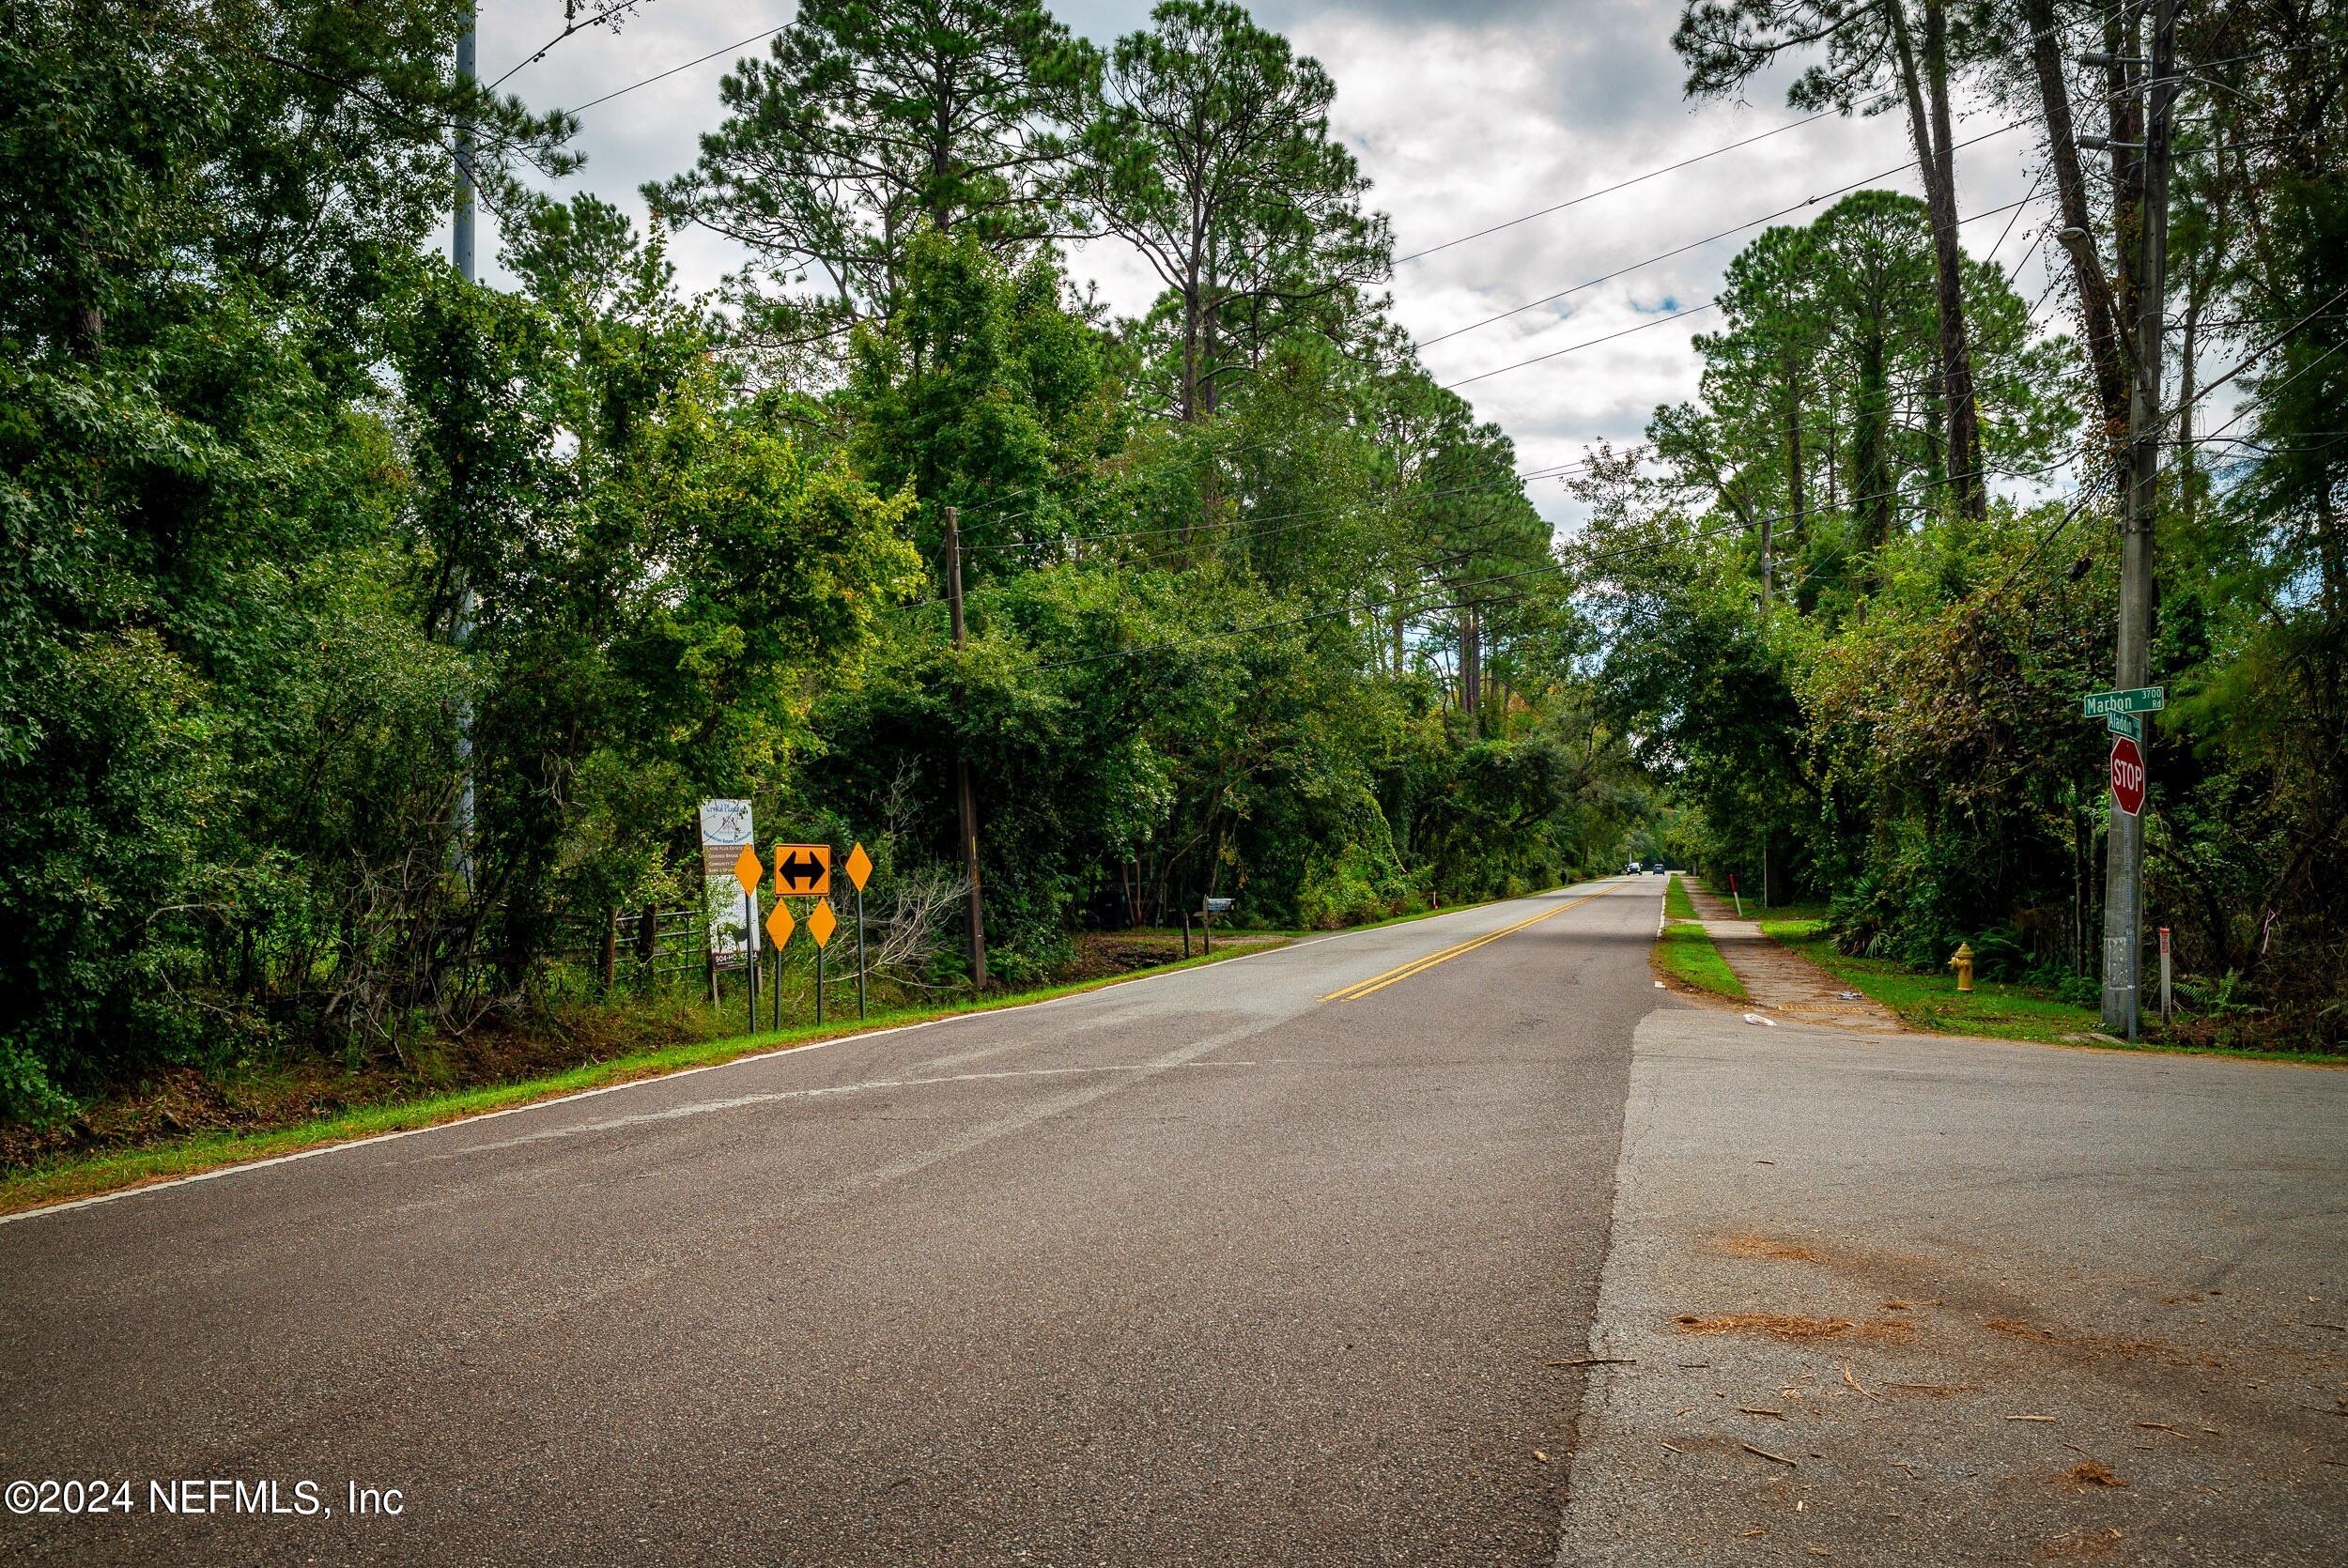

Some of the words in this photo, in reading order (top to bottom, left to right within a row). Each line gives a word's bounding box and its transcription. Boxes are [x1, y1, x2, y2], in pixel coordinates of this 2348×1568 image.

[2141, 689, 2162, 699] 3700
[2087, 696, 2132, 714] Marbon
[2152, 699, 2162, 709] Rd
[2109, 711, 2132, 734] Aladdin
[2114, 759, 2142, 792] STOP
